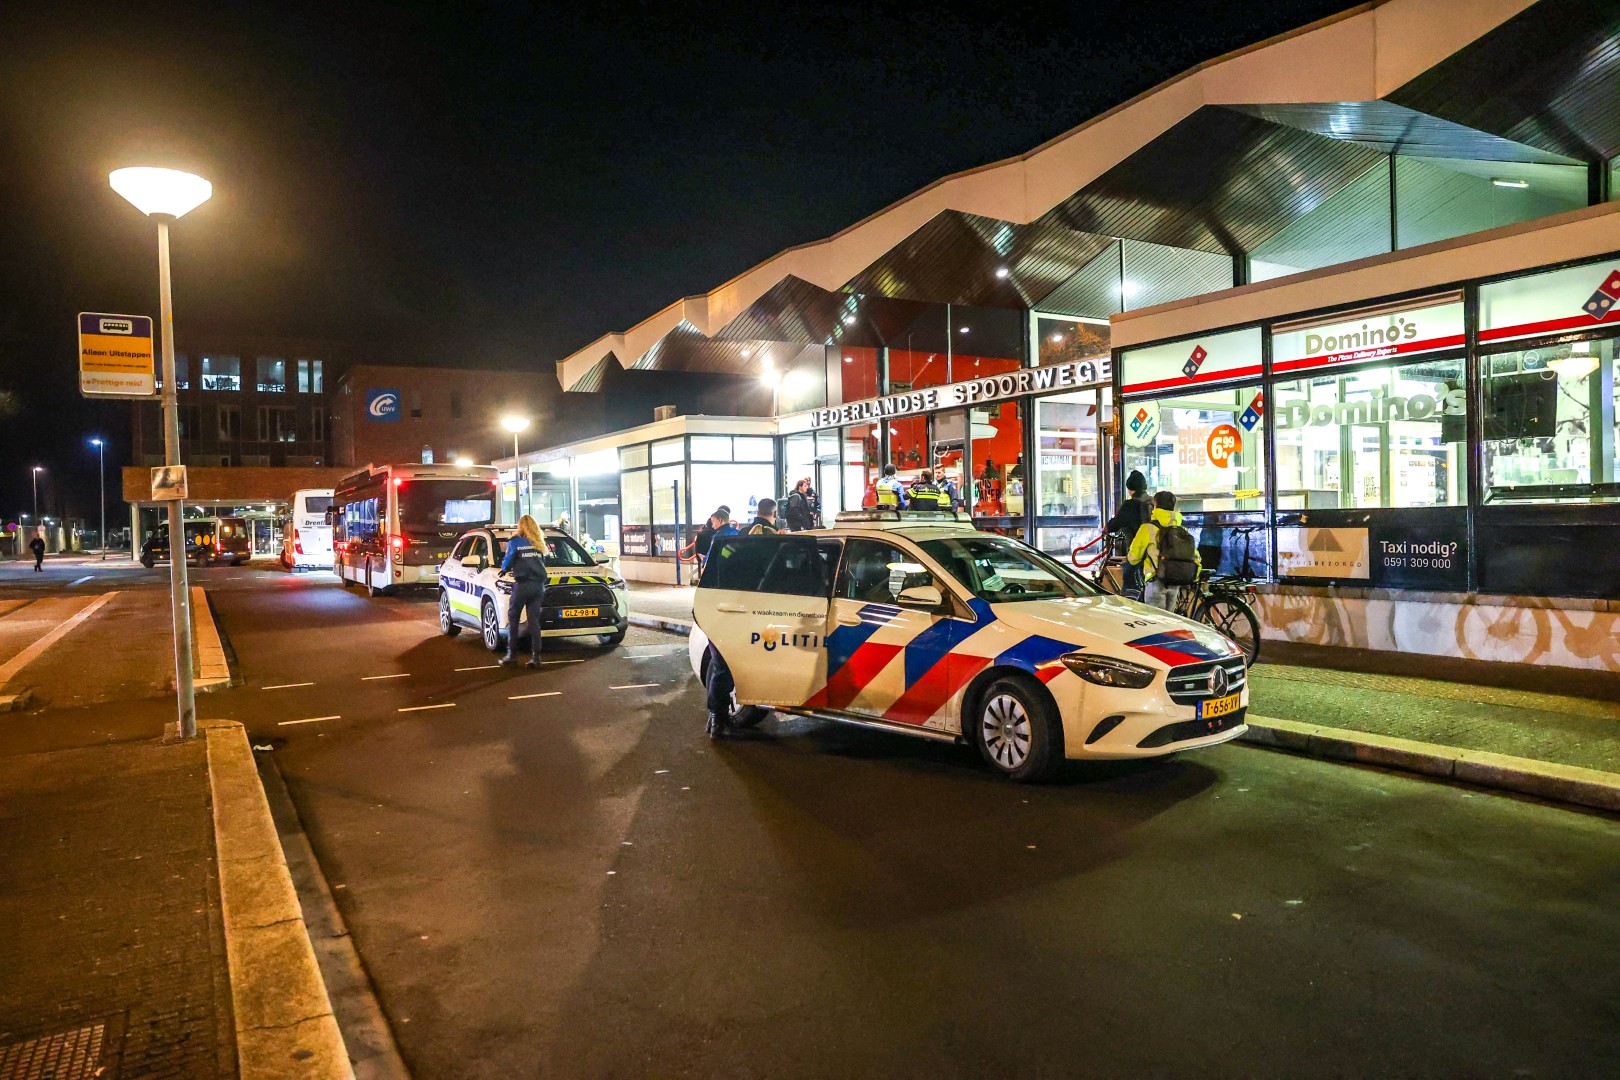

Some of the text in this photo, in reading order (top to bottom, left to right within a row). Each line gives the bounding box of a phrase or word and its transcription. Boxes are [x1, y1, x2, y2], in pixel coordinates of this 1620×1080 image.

[1305, 318, 1418, 355] Domino's
[82, 348, 151, 359] Alleen Uitstappen
[1327, 355, 1338, 363] The
[91, 378, 143, 387] Prettige reis!
[808, 357, 1112, 428] NEDERLANDSE SPOORWEGE
[1285, 382, 1467, 429] Domino's
[1179, 445, 1207, 468] dag
[1379, 540, 1458, 558] Taxi nodig?
[1384, 556, 1451, 569] 0591 309 000
[564, 609, 596, 617] GLZ-98-K
